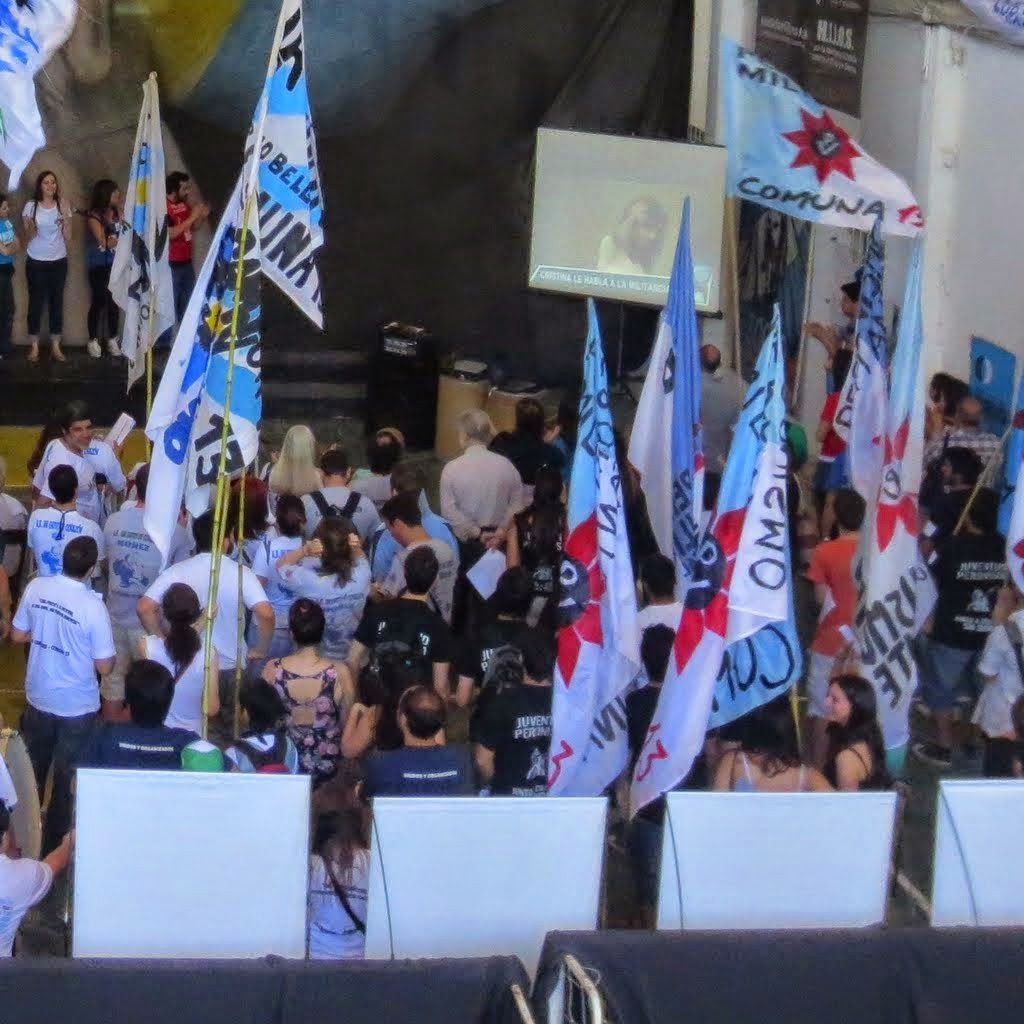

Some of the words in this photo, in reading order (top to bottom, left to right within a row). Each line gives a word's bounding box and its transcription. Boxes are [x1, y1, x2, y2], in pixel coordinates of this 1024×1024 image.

[737, 176, 886, 220] COMUNA
[540, 270, 572, 282] CRISTINA
[584, 276, 608, 288] HABLA
[629, 280, 670, 293] MILITANCI
[516, 715, 553, 729] JUVENT
